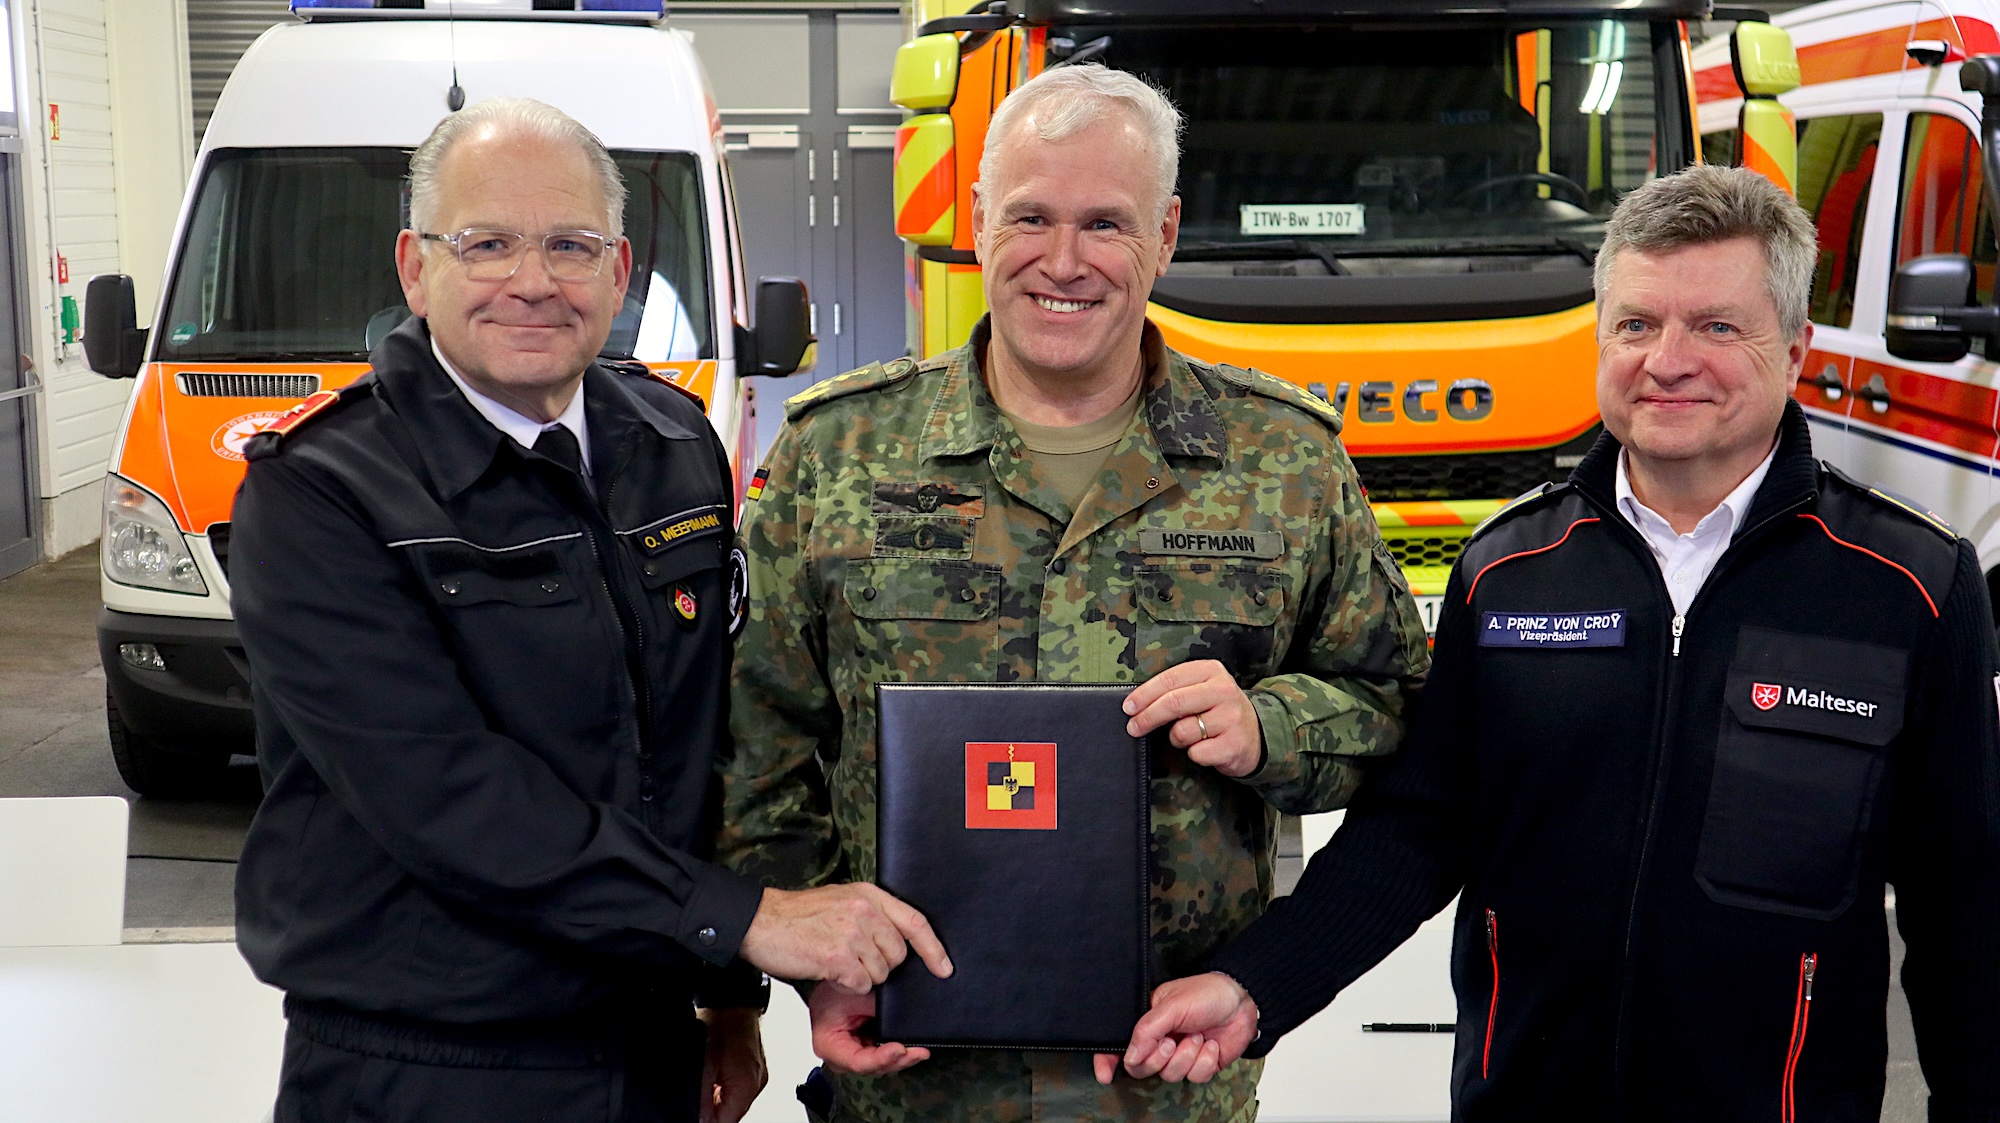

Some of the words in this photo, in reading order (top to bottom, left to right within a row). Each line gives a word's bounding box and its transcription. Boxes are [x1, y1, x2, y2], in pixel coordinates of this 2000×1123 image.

[1253, 211, 1310, 227] ITW-Bw
[1317, 211, 1352, 227] 1707
[1307, 377, 1495, 423] VECO
[644, 535, 661, 549] O.
[659, 513, 720, 542] MEERMANN
[1162, 532, 1256, 553] HOFFMANN
[1488, 616, 1502, 630] A.
[1506, 617, 1549, 631] PRINZ
[1553, 617, 1580, 631] VON
[1519, 630, 1589, 644] Vizepräsident
[1786, 686, 1878, 718] Malteser
